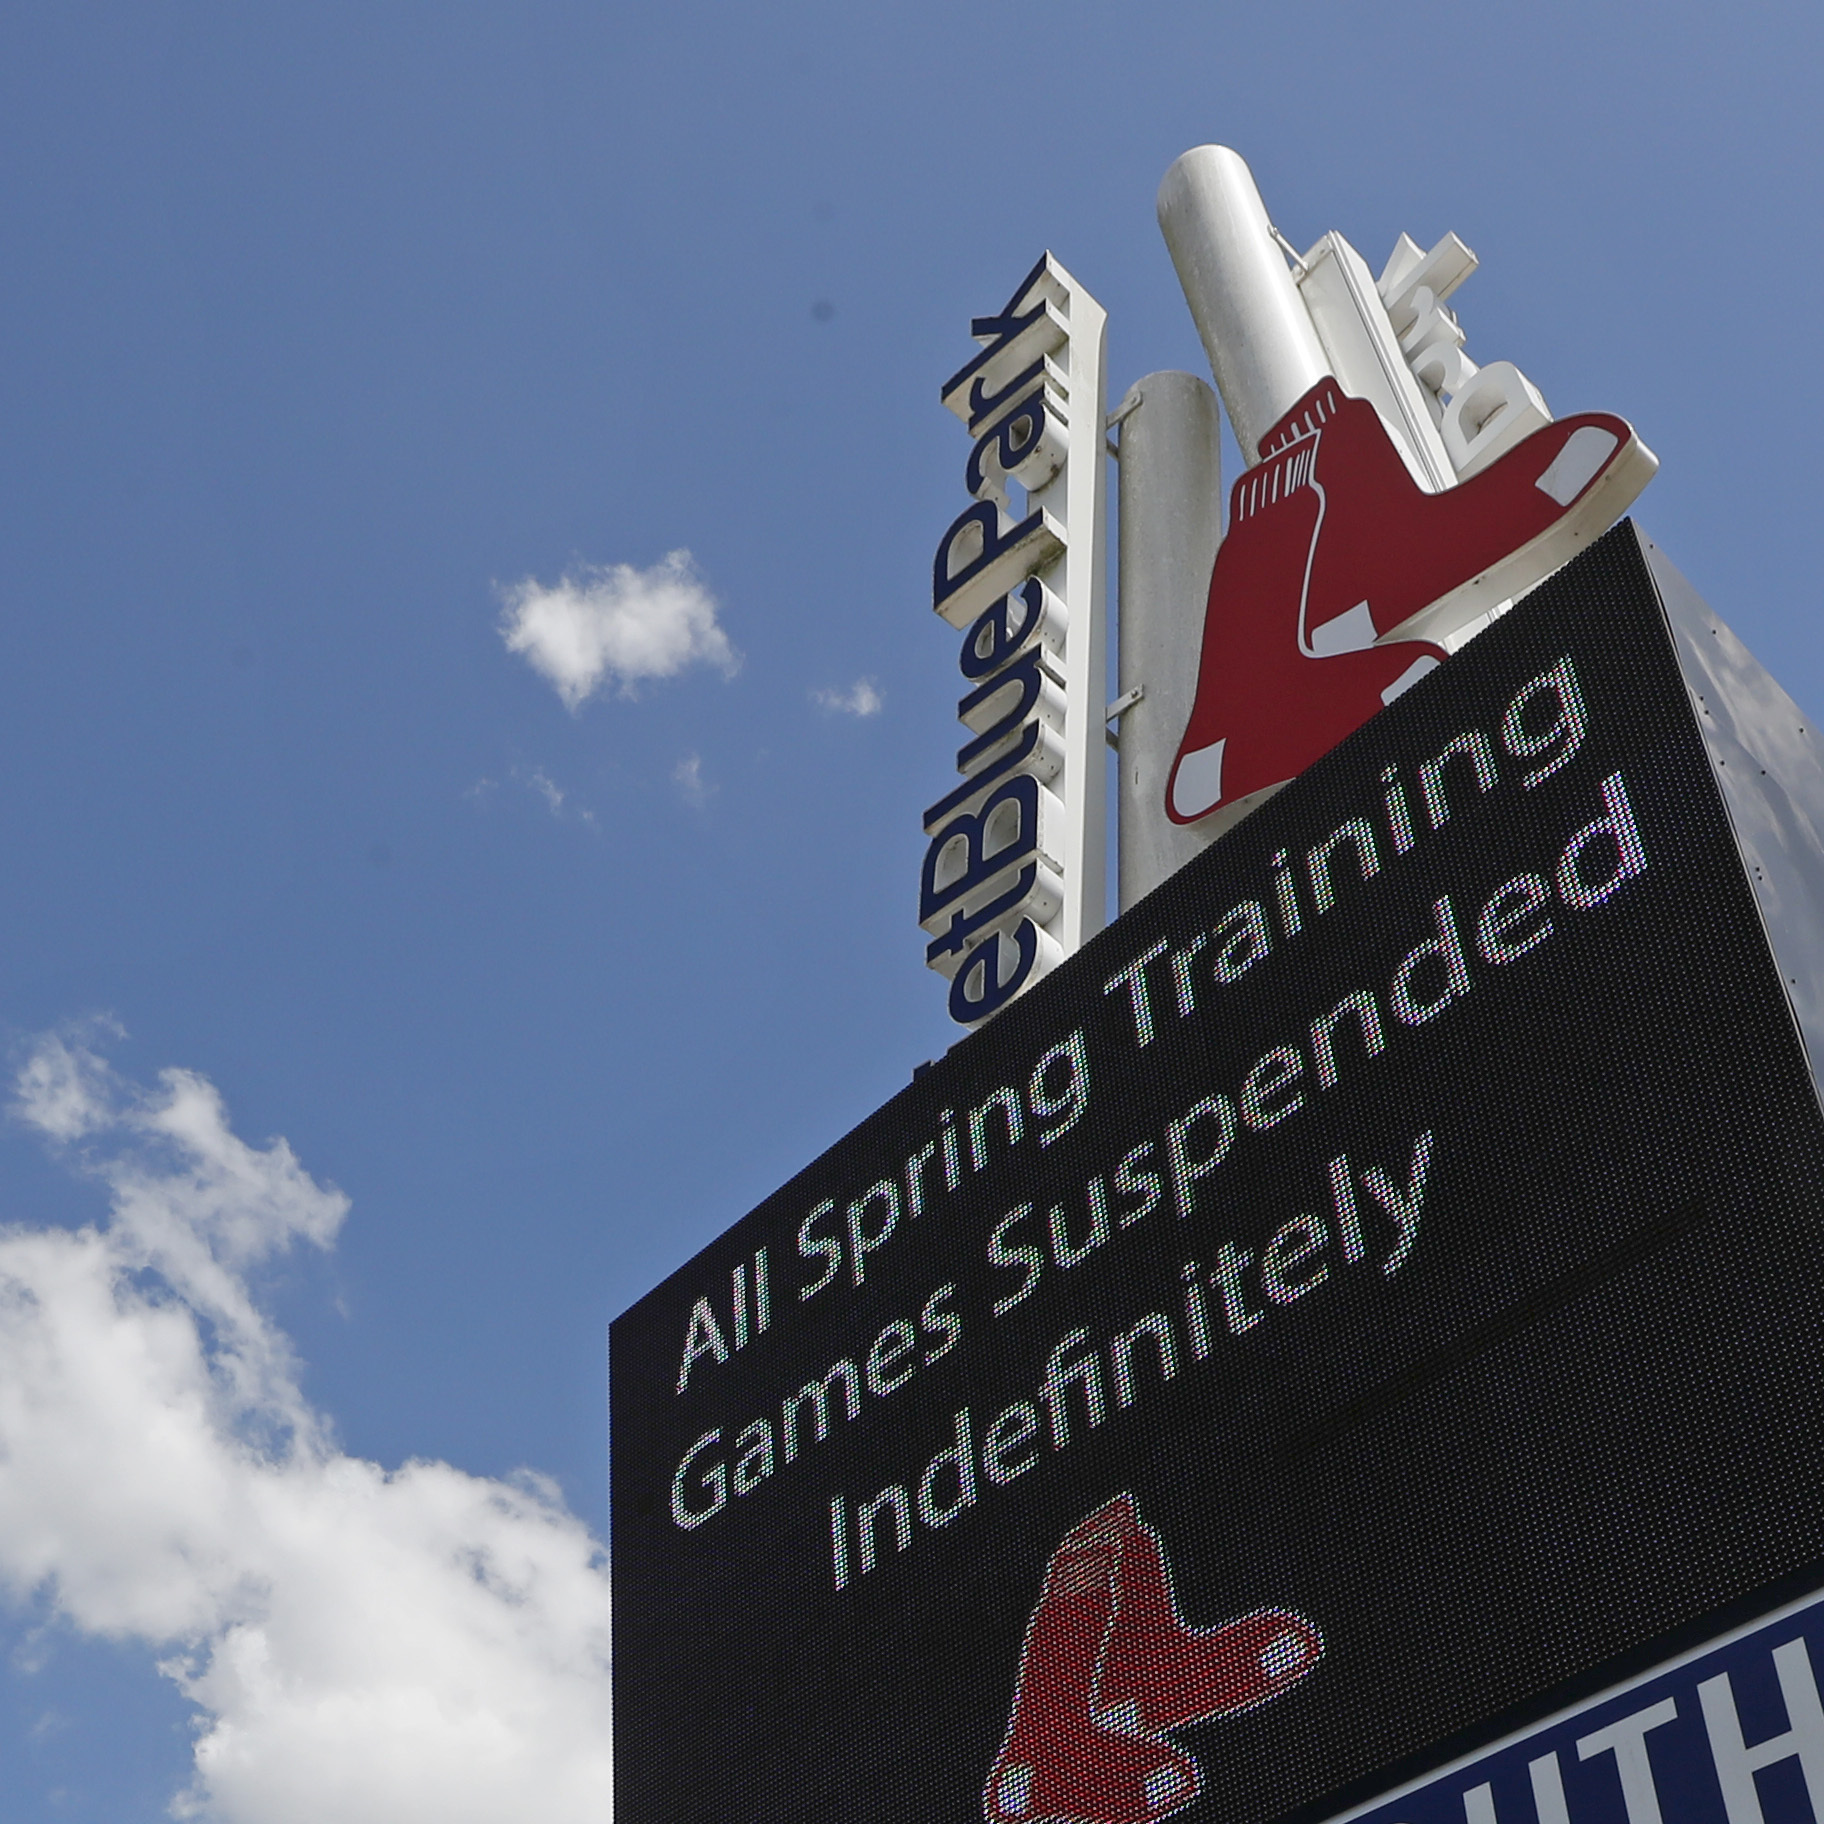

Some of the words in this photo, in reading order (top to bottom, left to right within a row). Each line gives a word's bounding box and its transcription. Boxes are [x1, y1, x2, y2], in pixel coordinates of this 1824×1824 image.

[933, 249, 1048, 612] Park
[677, 1250, 769, 1393] All
[797, 1032, 1088, 1299] Spring
[1104, 659, 1585, 1046] Training
[919, 575, 1043, 1024] etBlue
[670, 1286, 960, 1530] Games
[988, 771, 1647, 1314] Suspended
[831, 1133, 1432, 1590] Indefinitely
